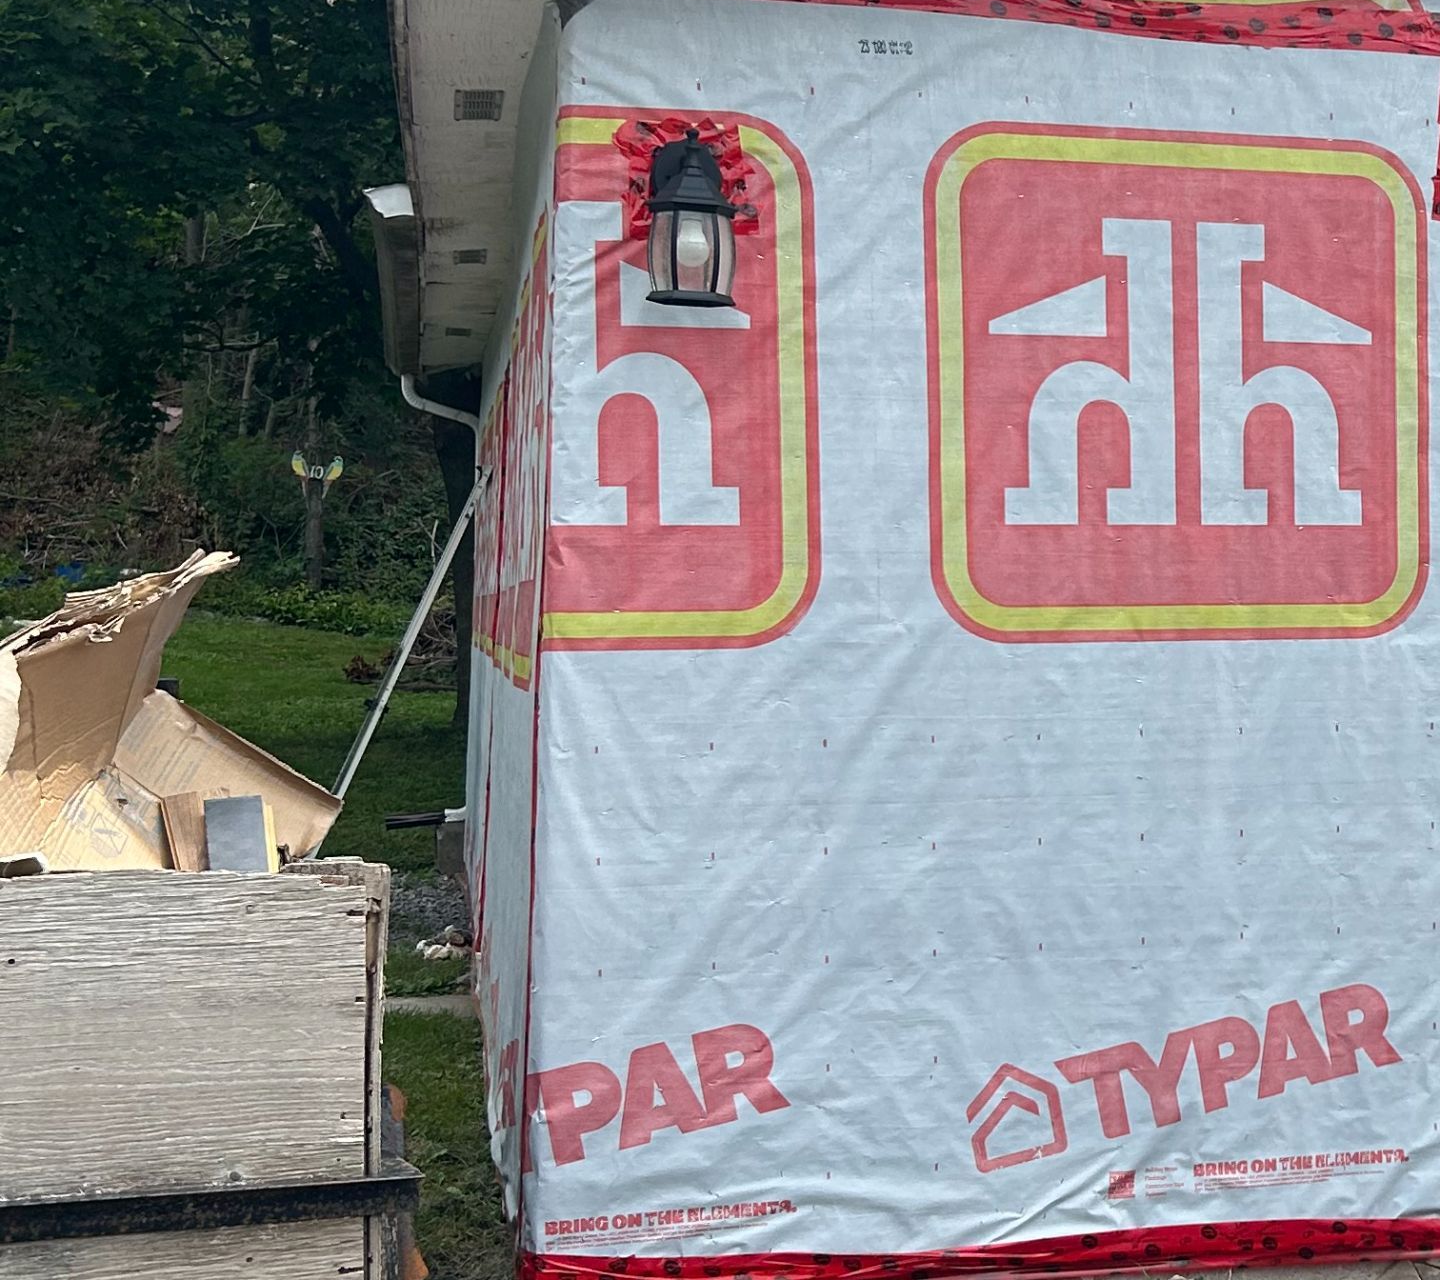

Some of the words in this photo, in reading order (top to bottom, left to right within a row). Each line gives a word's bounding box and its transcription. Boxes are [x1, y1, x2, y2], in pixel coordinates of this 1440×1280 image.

[1054, 983, 1402, 1140] TYPAR
[1193, 1160, 1248, 1177] BRING
[1251, 1158, 1277, 1173] ON
[1279, 1155, 1313, 1171] THE
[544, 1216, 608, 1235] BRING
[613, 1212, 642, 1229] ON
[644, 1208, 684, 1227] THE
